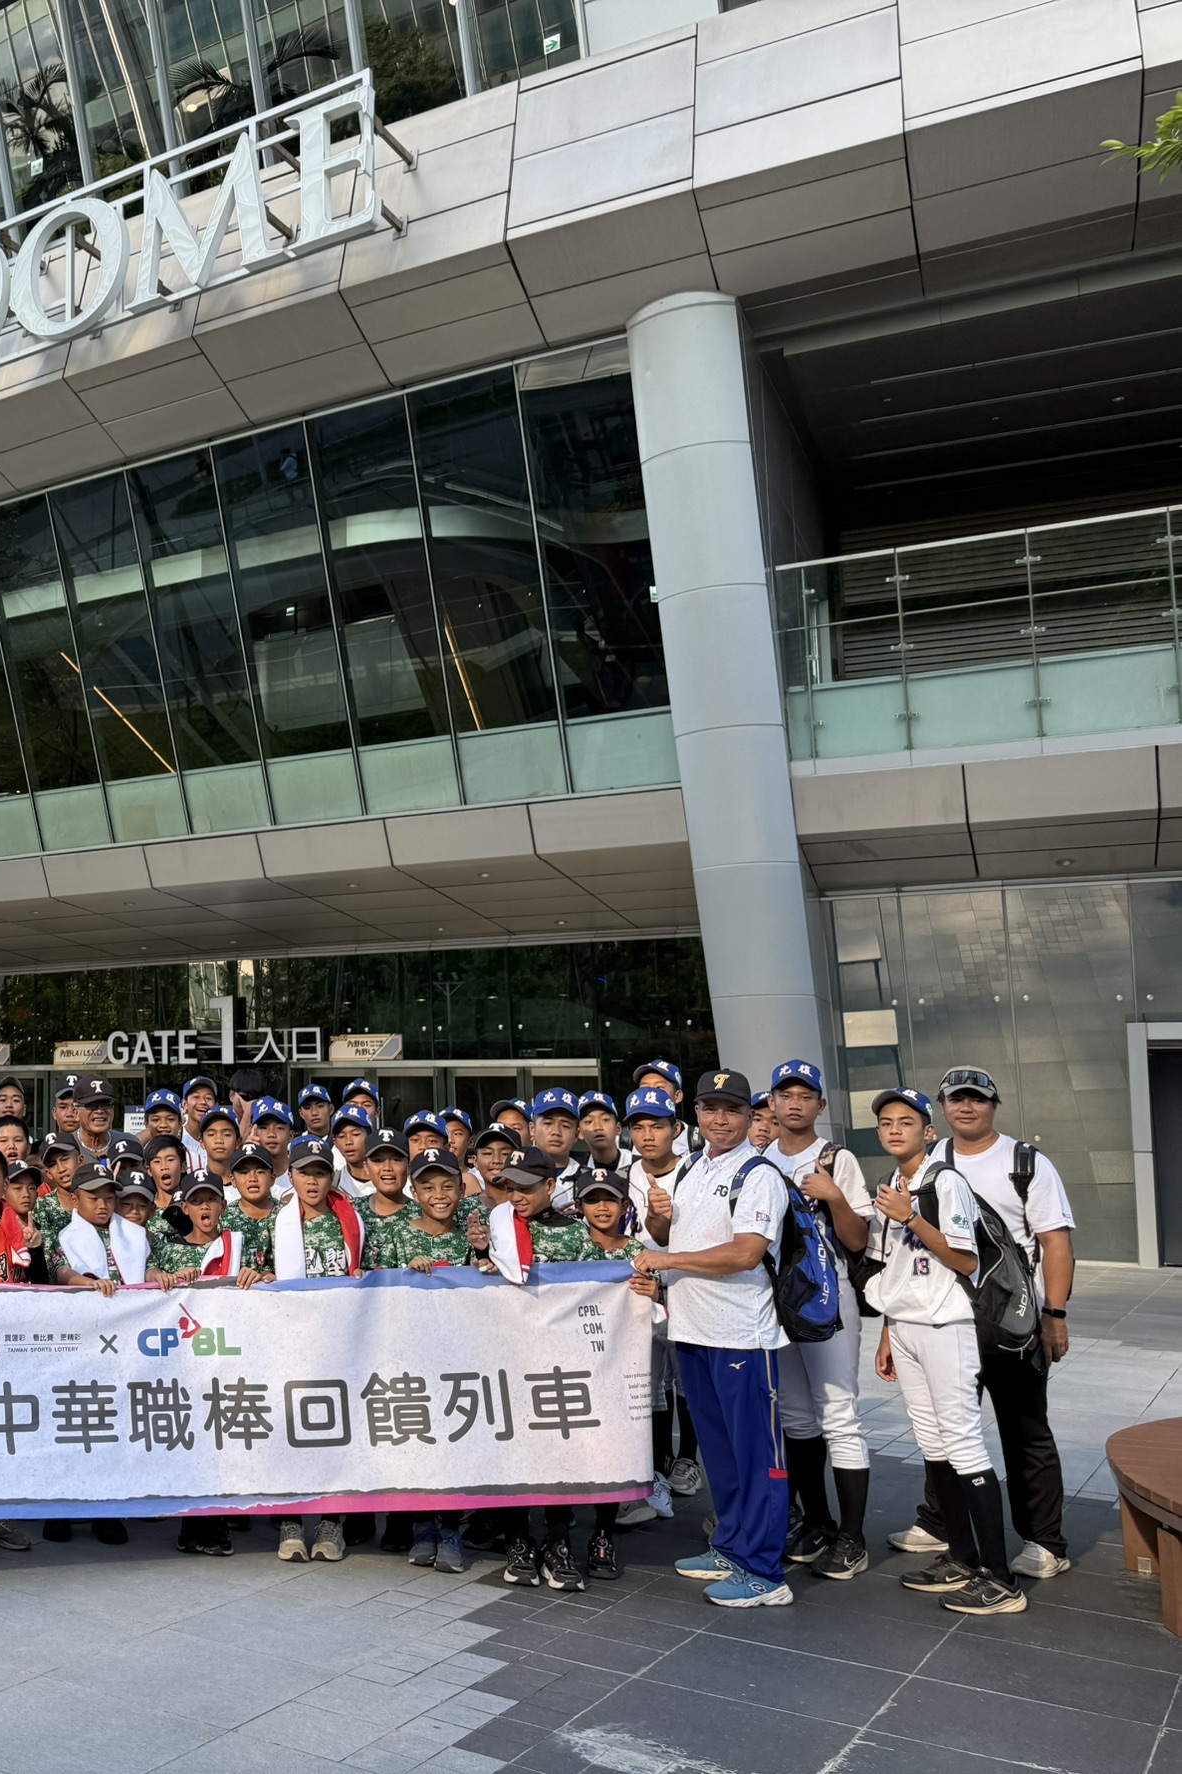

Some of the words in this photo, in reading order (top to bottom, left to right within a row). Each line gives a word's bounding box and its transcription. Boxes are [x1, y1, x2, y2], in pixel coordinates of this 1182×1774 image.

[107, 1030, 198, 1065] GATE
[209, 995, 234, 1064] 1
[253, 1026, 322, 1062] 入口
[66, 1075, 78, 1087] T
[90, 1080, 104, 1093] T
[912, 1257, 930, 1276] 13
[578, 1305, 605, 1317] CPBL.
[583, 1322, 607, 1335] COM.
[137, 1327, 242, 1357] CPBL
[590, 1341, 605, 1352] TW
